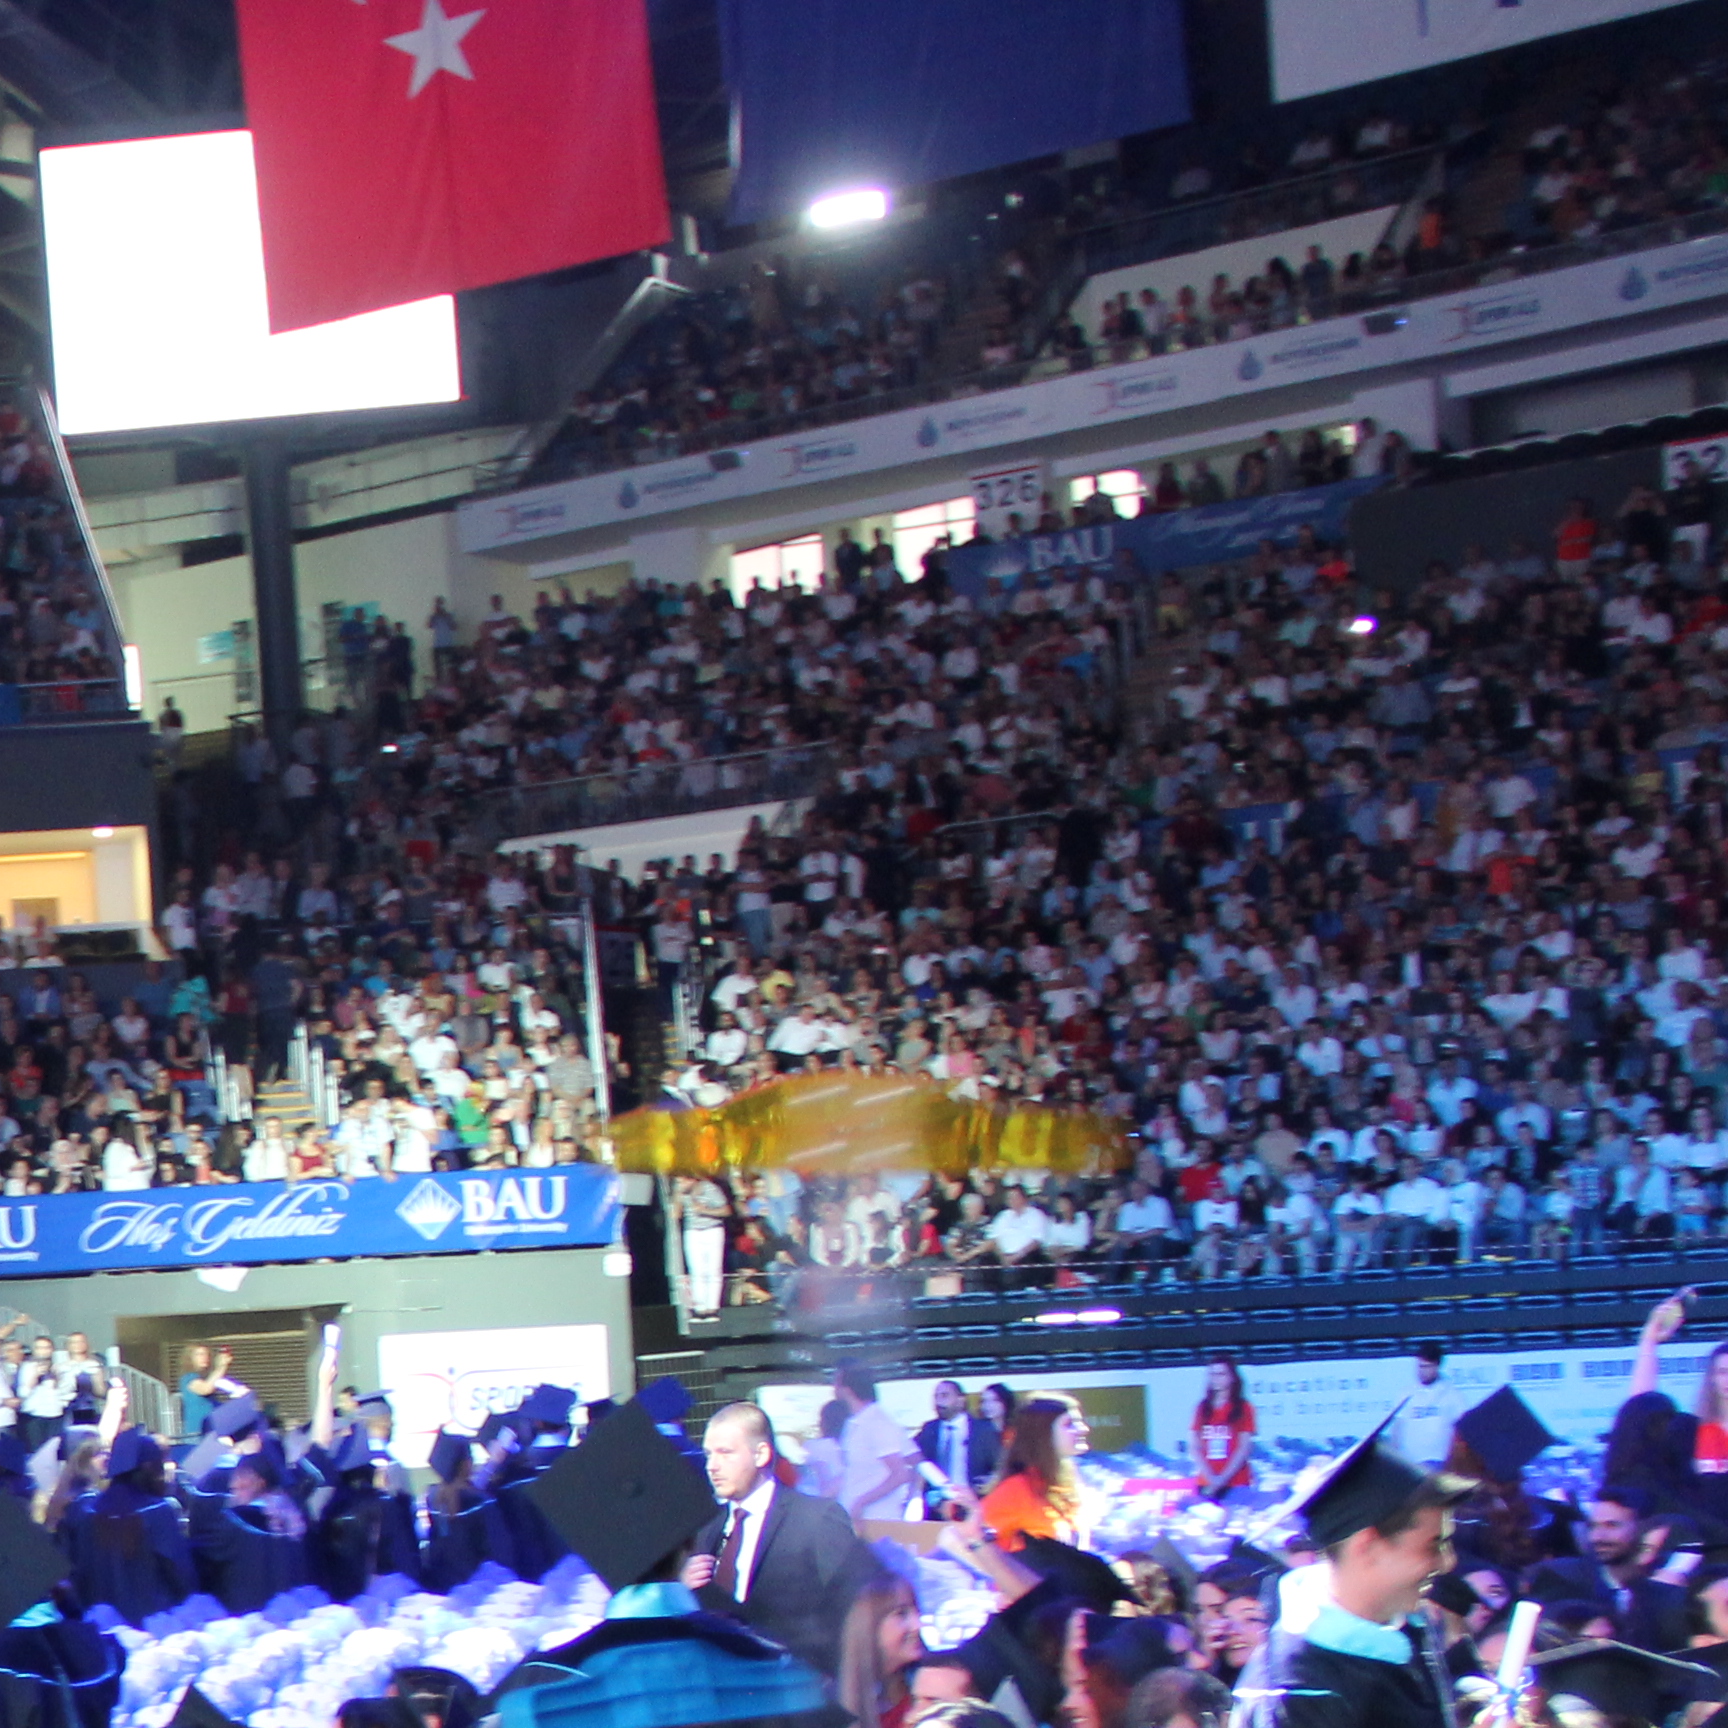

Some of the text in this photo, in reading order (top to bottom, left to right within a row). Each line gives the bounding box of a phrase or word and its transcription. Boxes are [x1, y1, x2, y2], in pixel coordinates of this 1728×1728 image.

[1029, 526, 1113, 570] BAU
[458, 1175, 569, 1223] BAU
[1249, 1376, 1371, 1394] ducation
